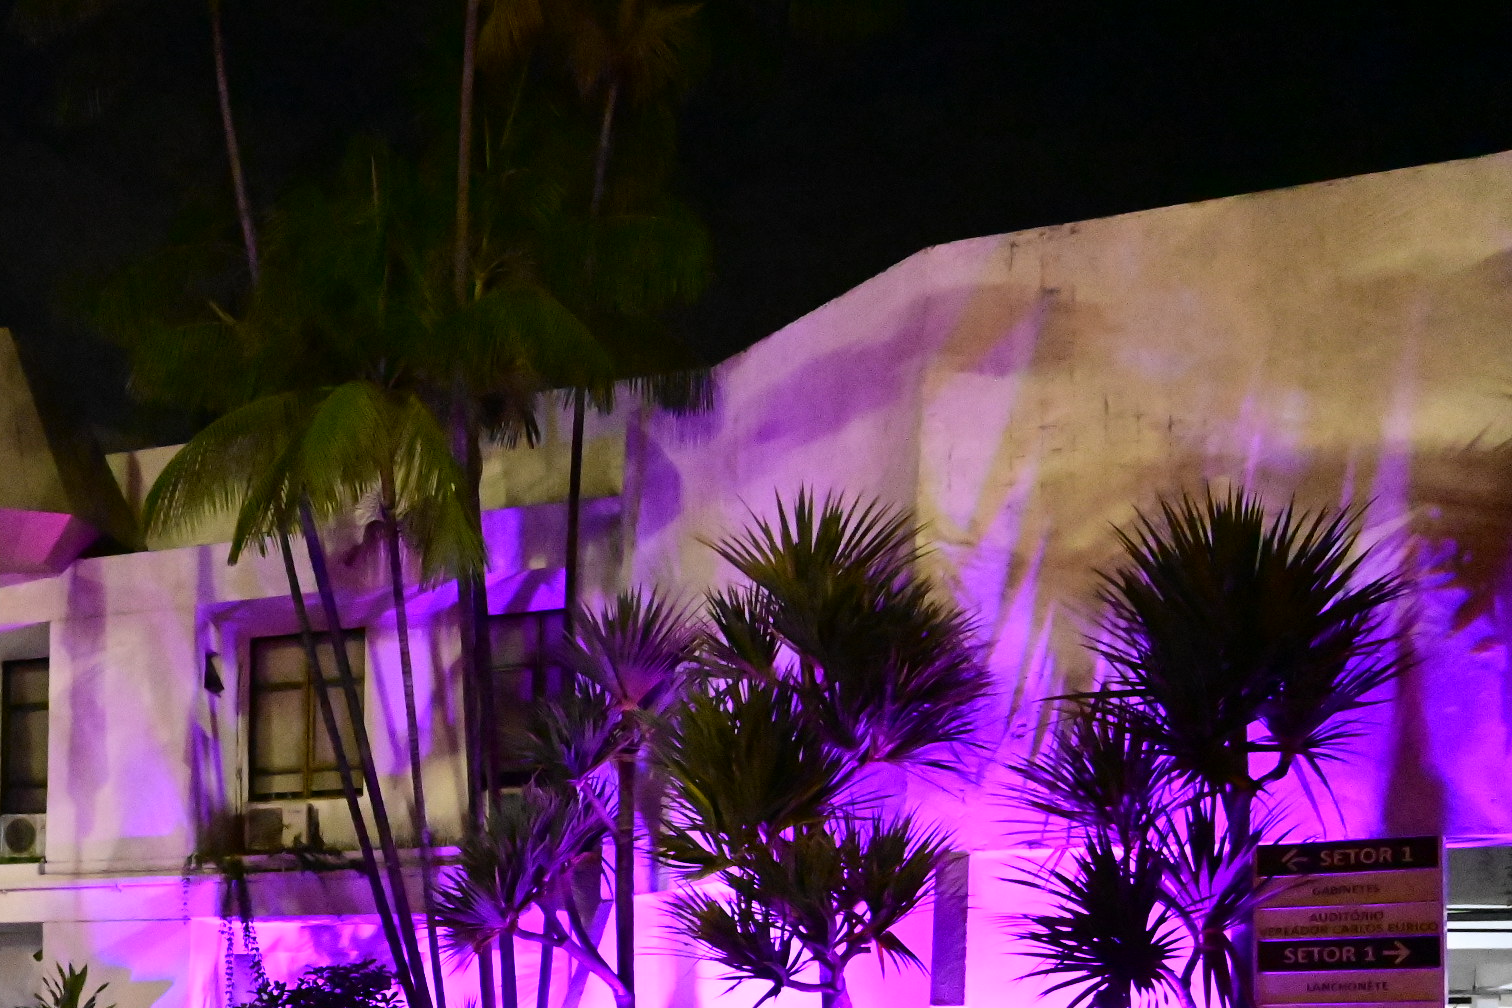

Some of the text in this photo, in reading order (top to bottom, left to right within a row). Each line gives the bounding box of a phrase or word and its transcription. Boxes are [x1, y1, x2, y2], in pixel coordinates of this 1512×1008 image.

[1319, 846, 1414, 867] SETOR 1
[1311, 884, 1381, 897] GABINETES
[1309, 910, 1384, 923] AUDITÓRIO
[1332, 923, 1383, 935] CARLOS
[1387, 921, 1439, 932] EURICO
[1283, 945, 1376, 963] SETOR 1
